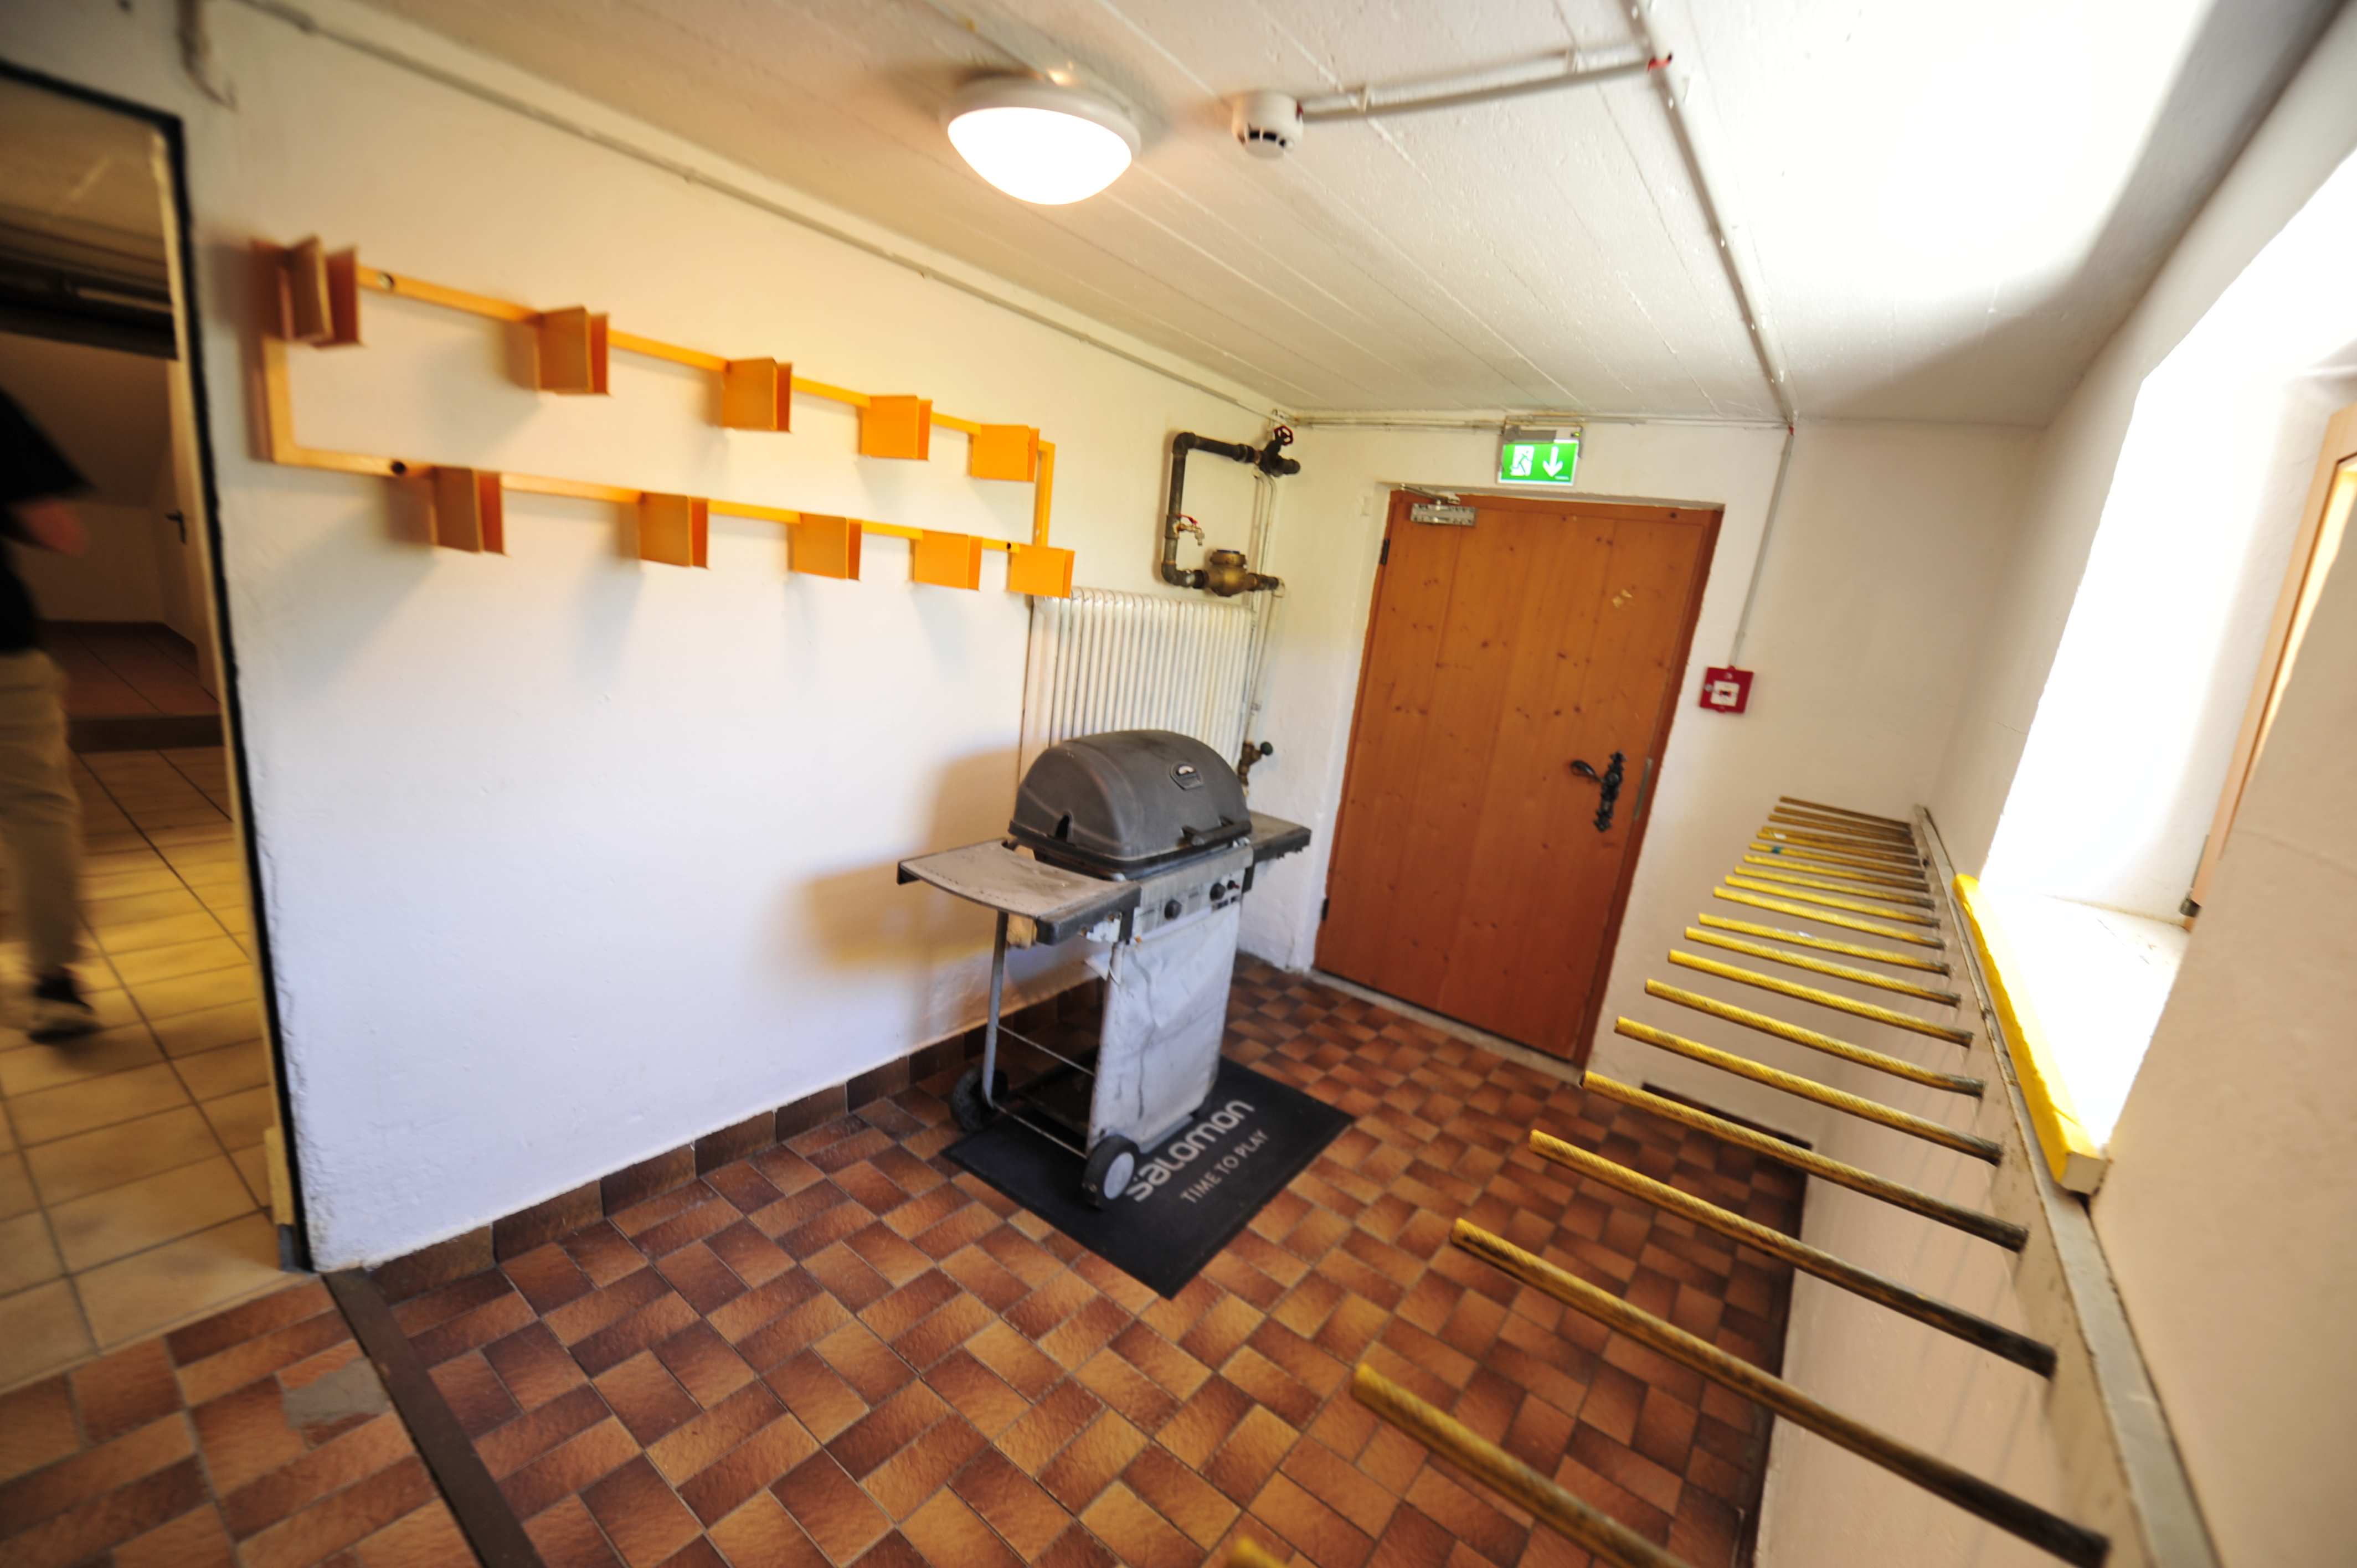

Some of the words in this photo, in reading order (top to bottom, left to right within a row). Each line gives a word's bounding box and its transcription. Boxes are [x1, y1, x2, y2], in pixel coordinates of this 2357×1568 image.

[1181, 1172, 1222, 1203] TIME
[1214, 1155, 1239, 1174] TO
[1234, 1129, 1268, 1158] PLAY
